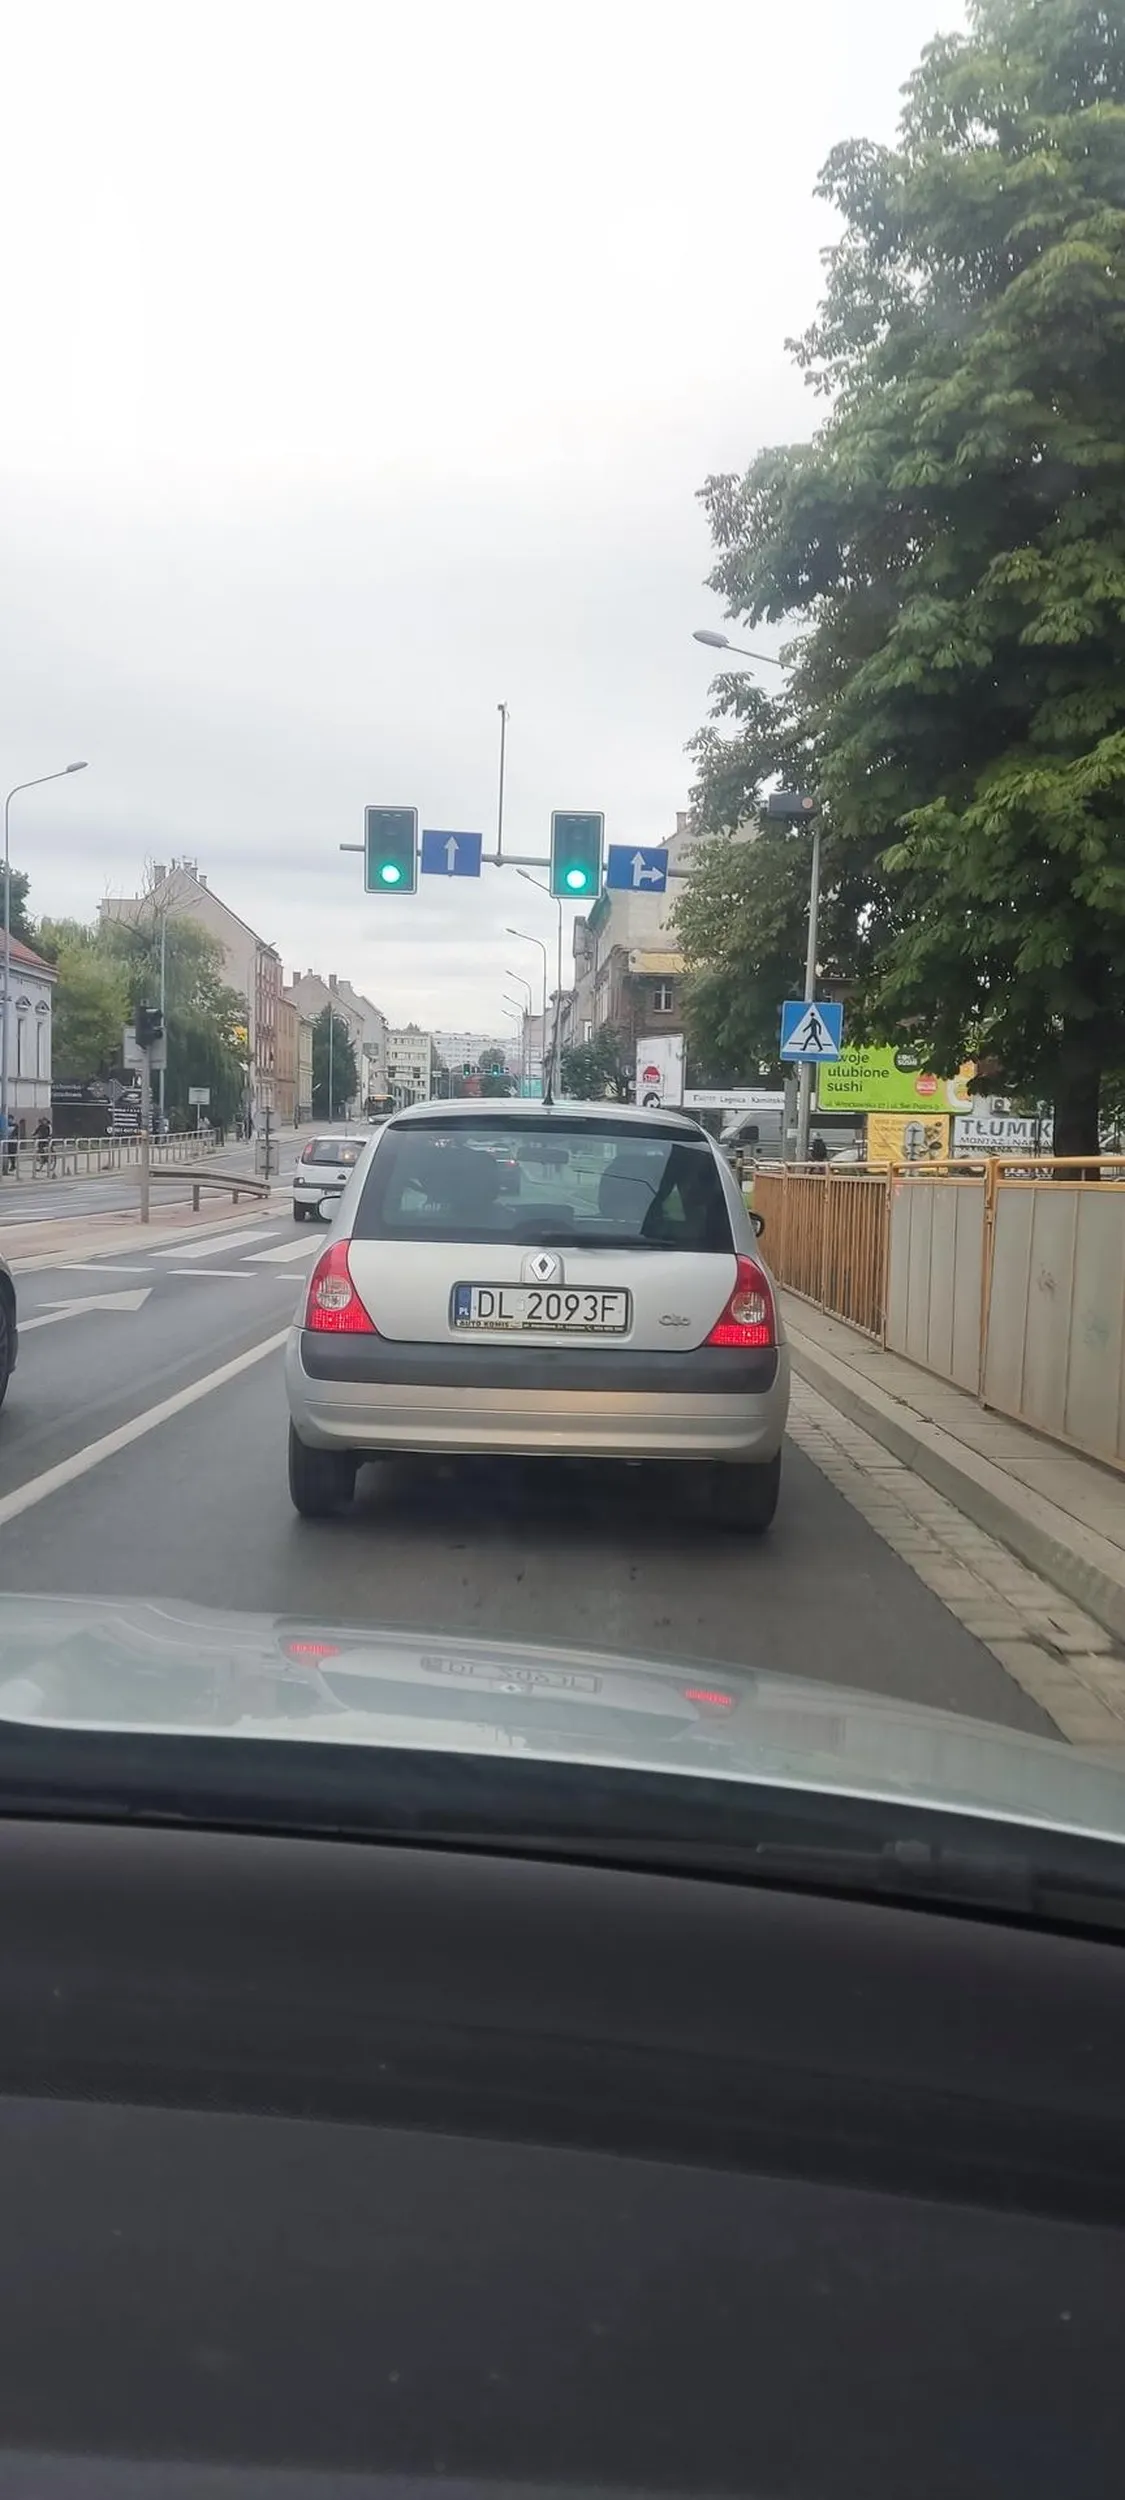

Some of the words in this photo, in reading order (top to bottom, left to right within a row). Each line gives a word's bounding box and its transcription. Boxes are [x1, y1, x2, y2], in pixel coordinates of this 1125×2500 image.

[840, 1053, 870, 1065] woje
[827, 1066, 890, 1078] ulubione
[826, 1080, 863, 1092] sushi
[458, 1306, 470, 1316] PL
[477, 1290, 514, 1319] DL
[526, 1292, 619, 1322] 2093F
